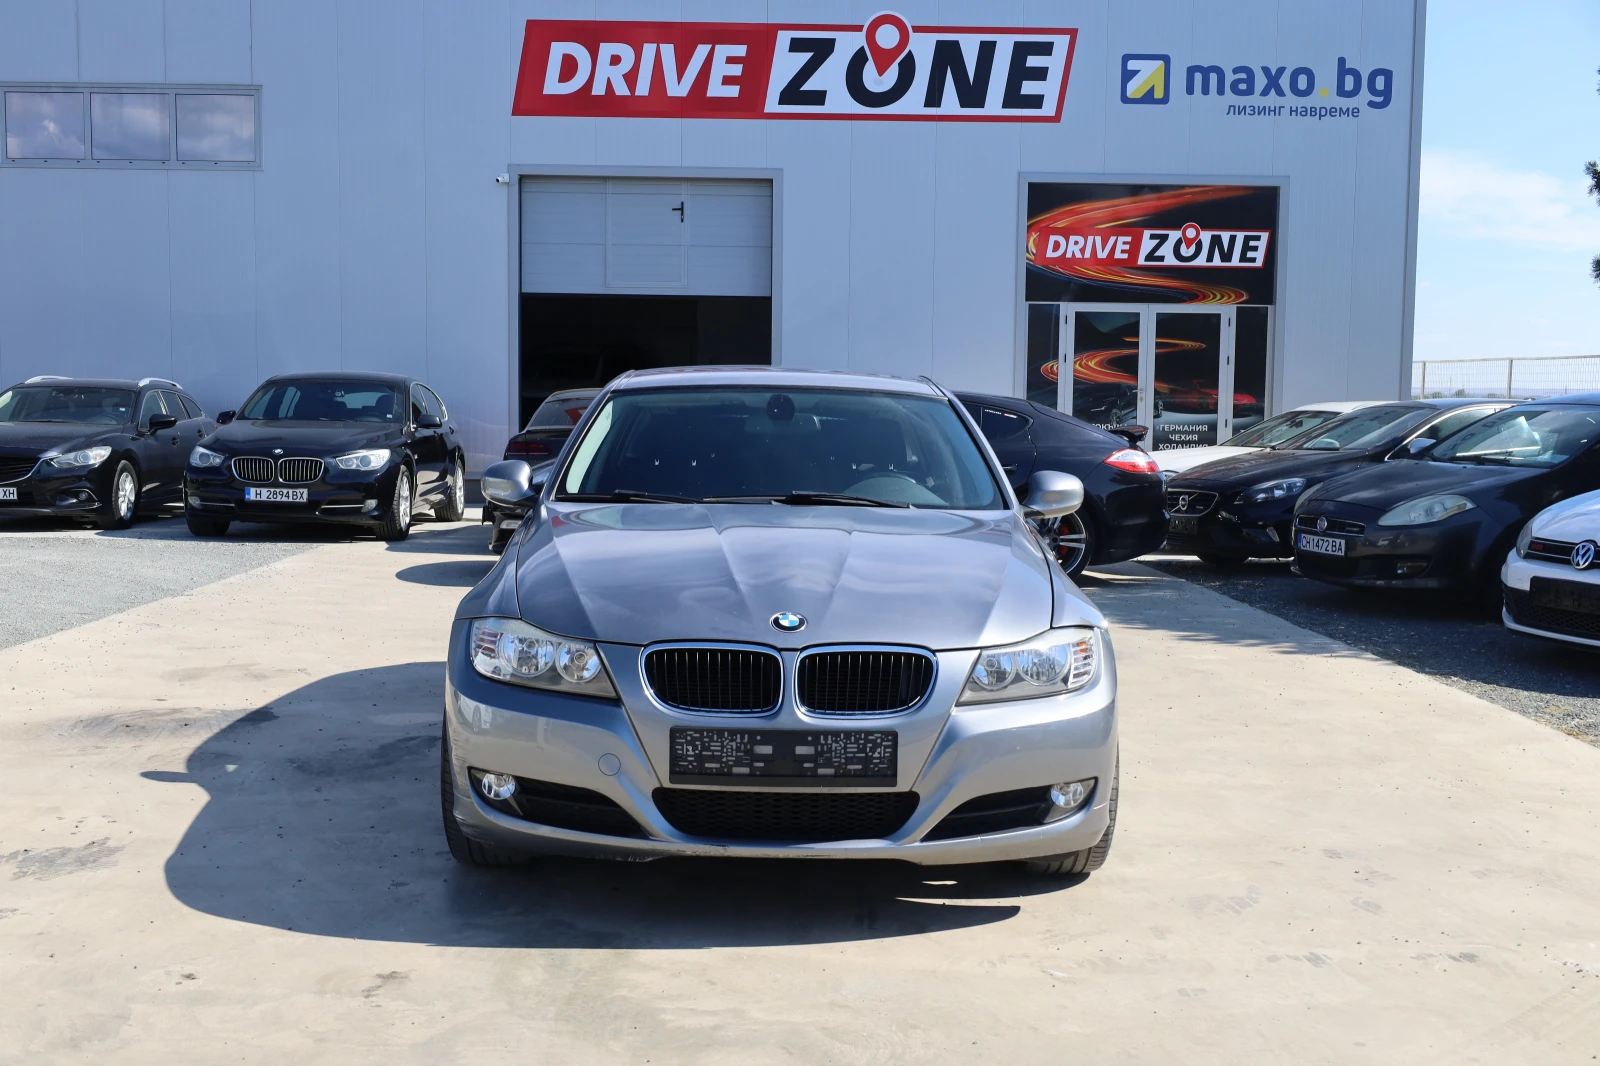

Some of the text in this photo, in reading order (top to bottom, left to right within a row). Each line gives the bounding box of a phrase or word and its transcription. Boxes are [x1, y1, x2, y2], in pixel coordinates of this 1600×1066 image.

[542, 36, 1055, 110] DRIVE ZONE
[1185, 56, 1394, 110] maxo.bg
[1226, 104, 1361, 121] лизинг навреме
[1045, 233, 1262, 264] DRIVE ZONE
[1159, 424, 1208, 432] ГЕРМАНИЯ
[1169, 433, 1198, 441] ЧЕХИЯ
